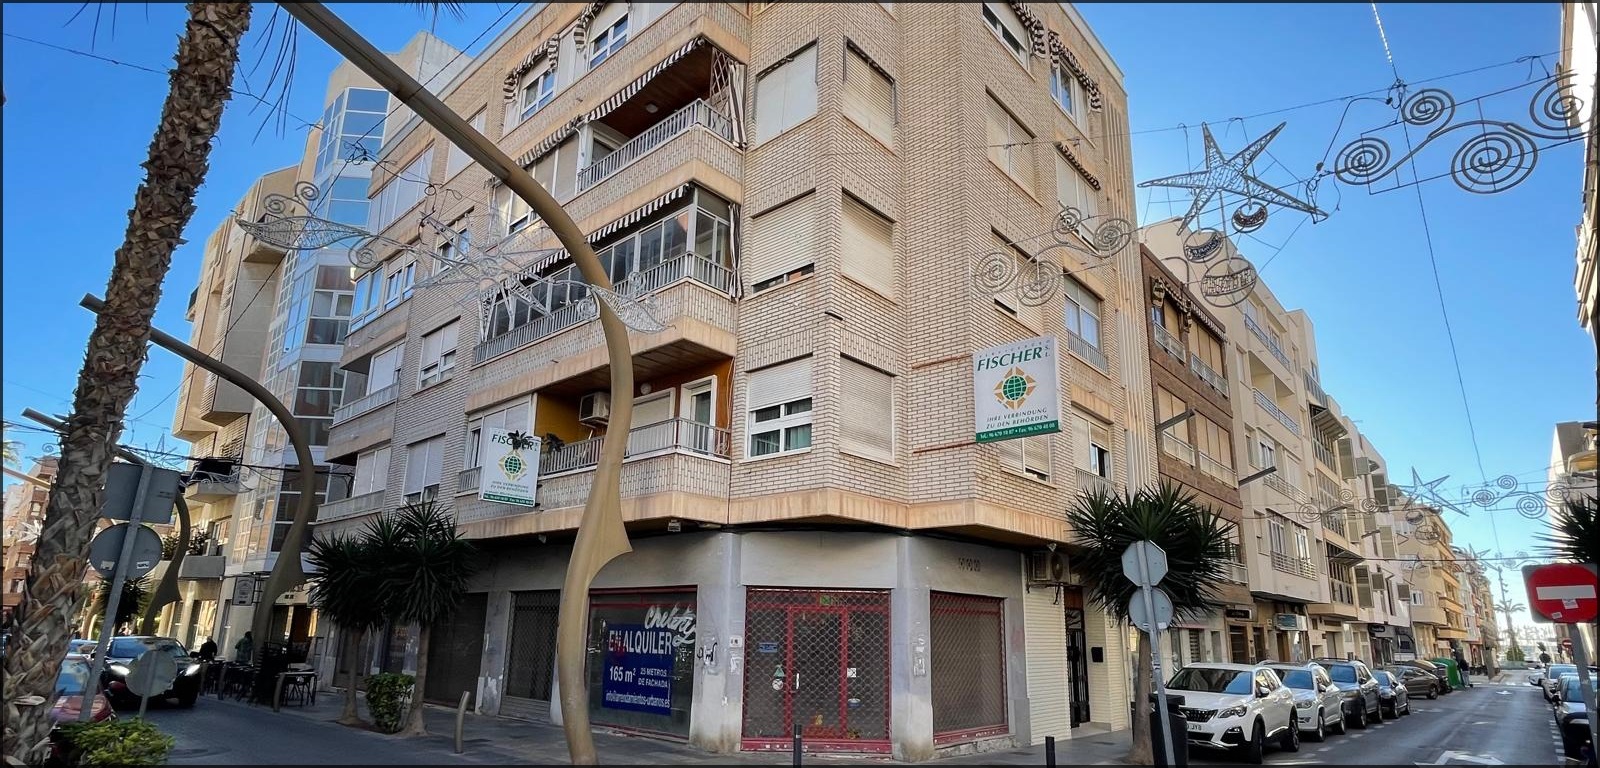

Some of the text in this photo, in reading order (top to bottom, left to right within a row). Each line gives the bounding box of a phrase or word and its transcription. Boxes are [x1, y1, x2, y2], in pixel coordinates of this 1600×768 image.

[977, 346, 1043, 371] FISCHER
[1003, 408, 1047, 419] VERBINDUNG
[1012, 414, 1049, 425] BEHÖRDEN
[491, 434, 534, 450] FISCER
[608, 630, 622, 651] EN
[622, 630, 672, 655] ALQUILER
[609, 666, 624, 682] 165
[646, 668, 667, 677] METROS
[645, 679, 668, 688] FACHADA
